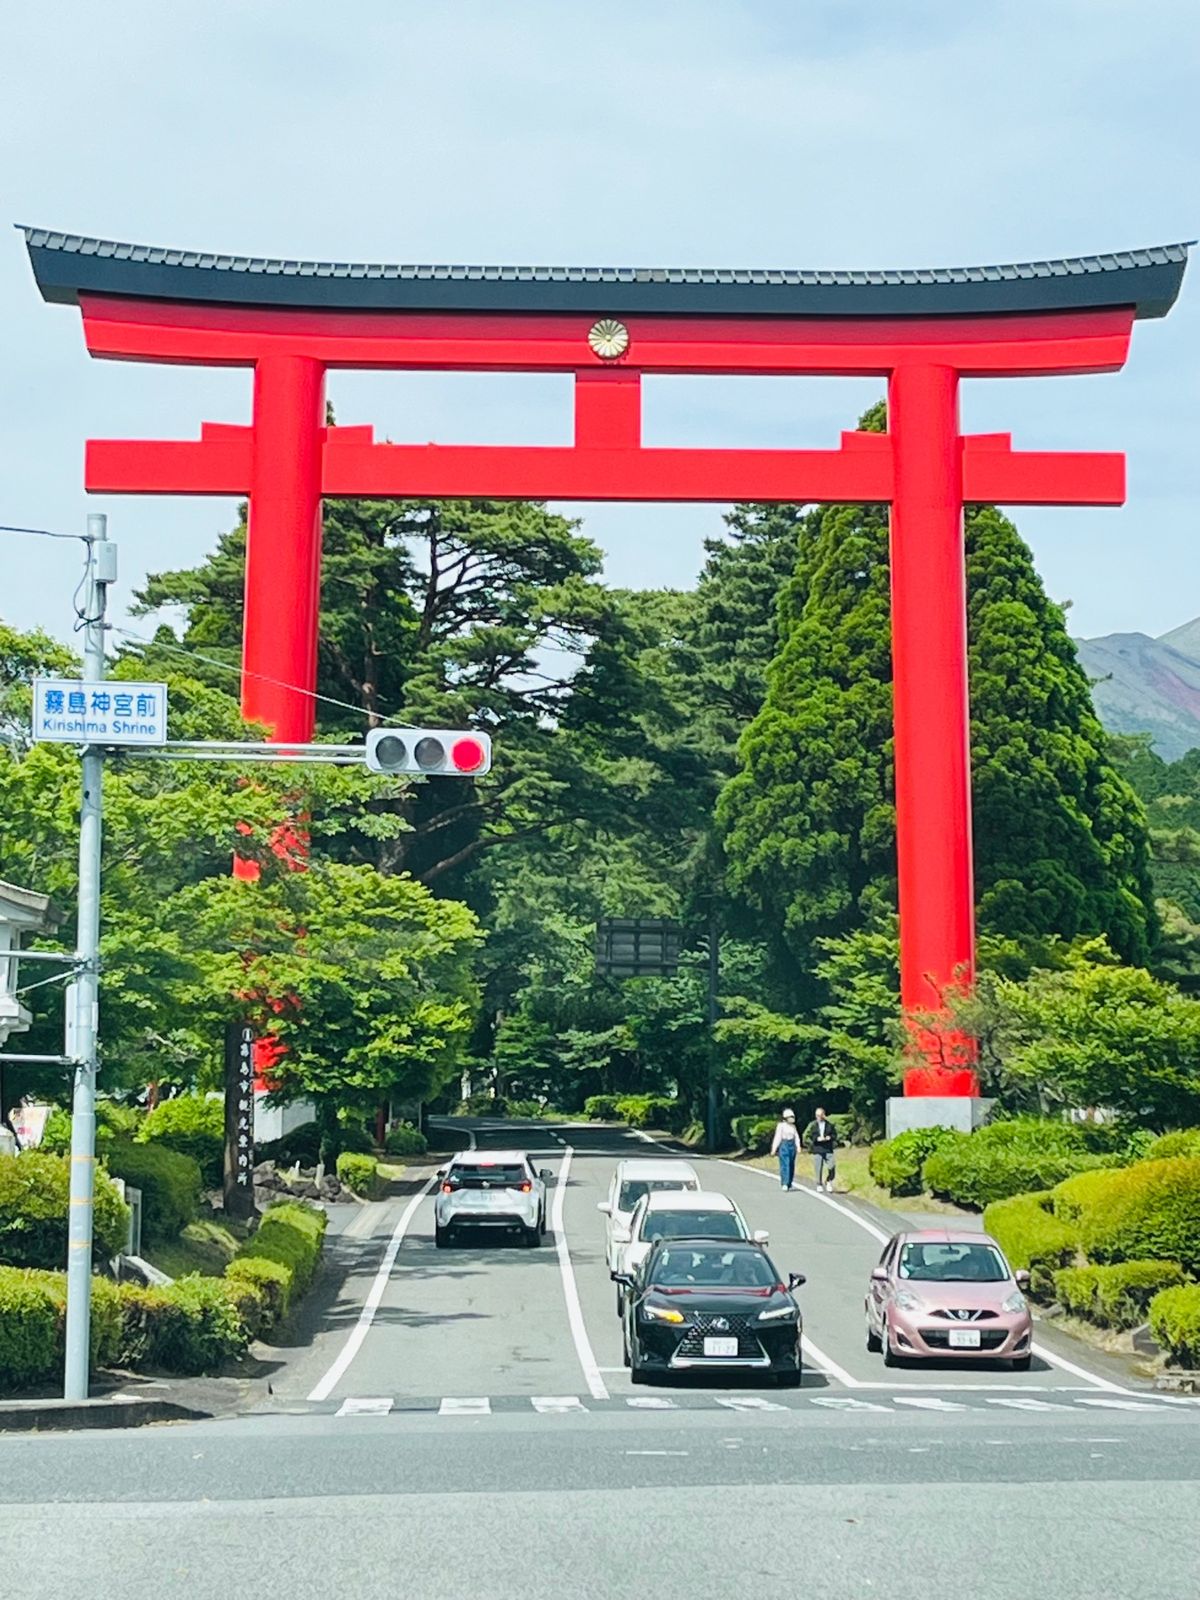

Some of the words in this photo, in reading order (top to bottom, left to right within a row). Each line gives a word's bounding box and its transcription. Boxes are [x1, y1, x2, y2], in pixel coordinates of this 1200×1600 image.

[45, 690, 156, 717] 霧島神宮前
[43, 719, 107, 733] Kirishima
[112, 720, 156, 735] Shrine
